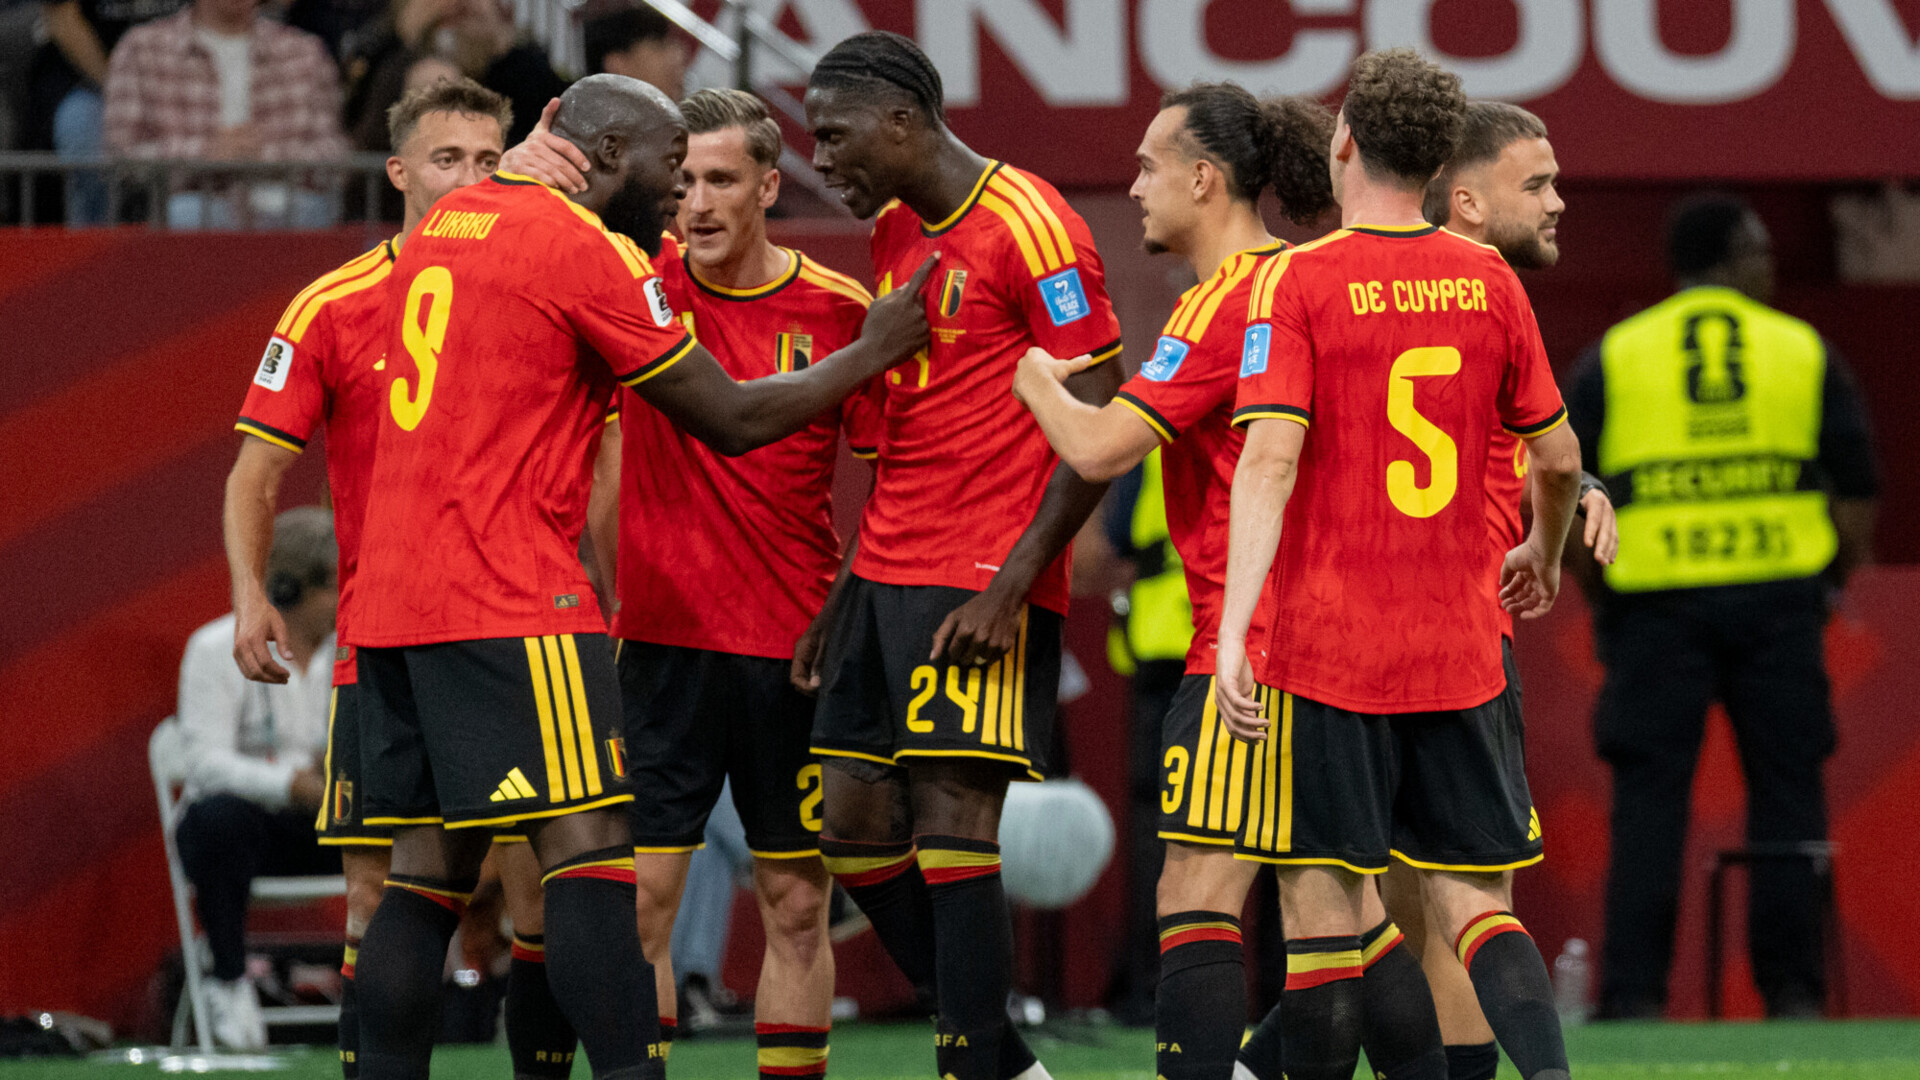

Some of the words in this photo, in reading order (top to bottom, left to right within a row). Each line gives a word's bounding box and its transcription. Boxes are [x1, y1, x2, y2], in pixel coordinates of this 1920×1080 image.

[422, 209, 500, 240] LUKAKU
[1348, 280, 1387, 315] DE
[1392, 278, 1488, 312] CUYPER
[390, 266, 453, 432] 9
[1386, 346, 1462, 519] 5
[1634, 459, 1799, 500] SECURITY
[906, 665, 981, 733] 24
[796, 763, 824, 832] 2
[1161, 745, 1190, 814] 3
[1156, 1043, 1182, 1053] FA
